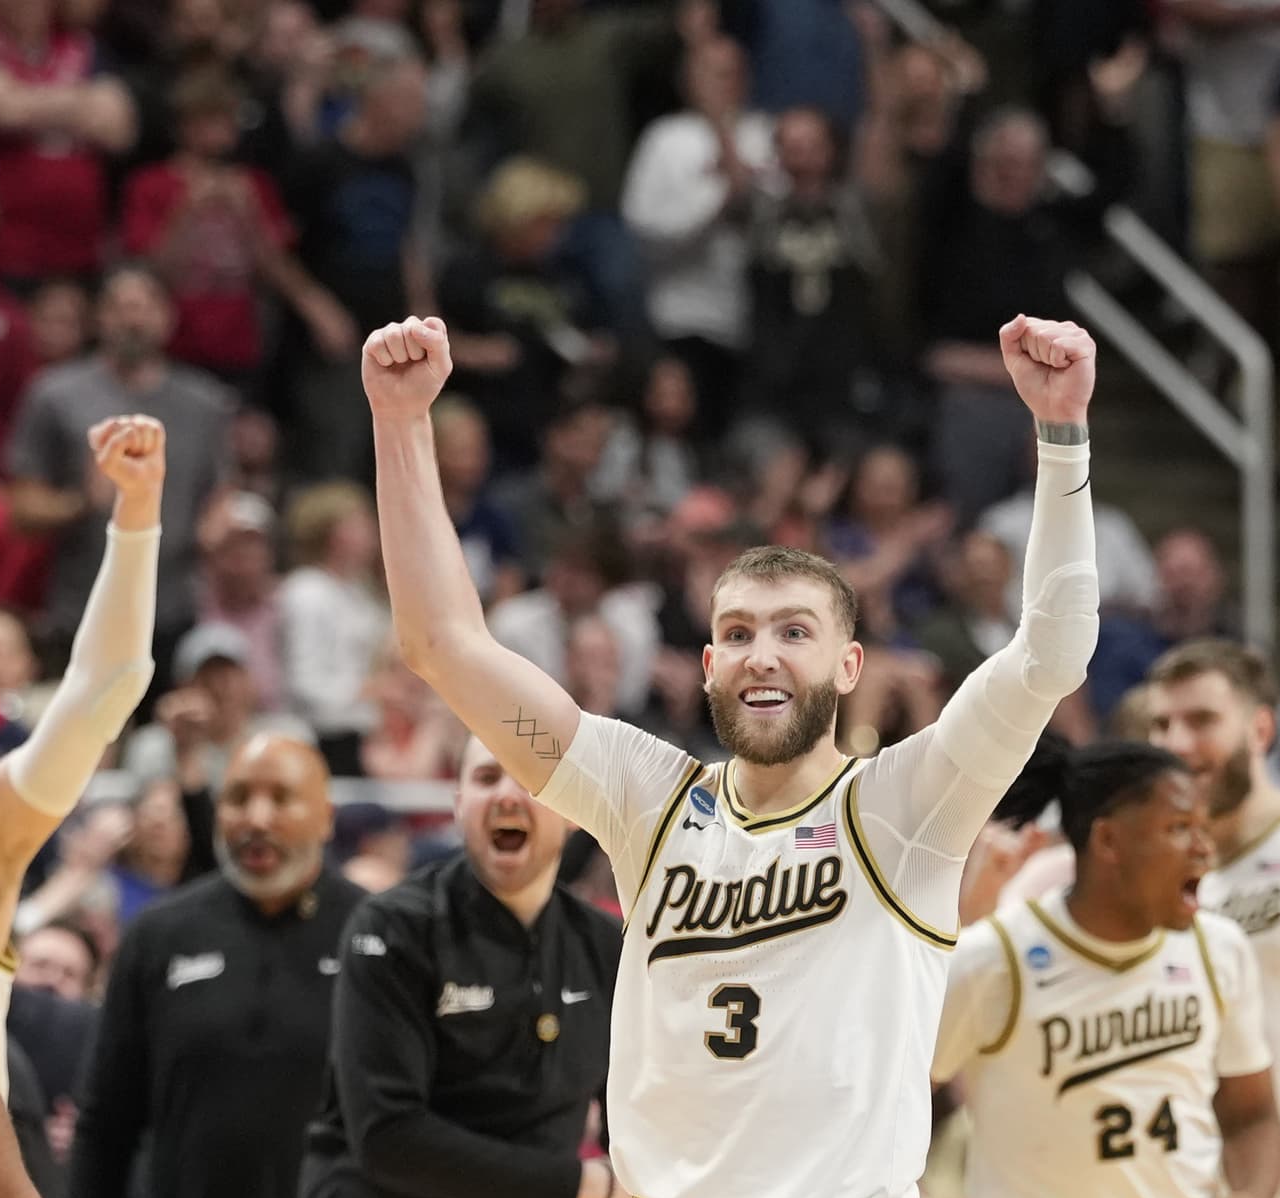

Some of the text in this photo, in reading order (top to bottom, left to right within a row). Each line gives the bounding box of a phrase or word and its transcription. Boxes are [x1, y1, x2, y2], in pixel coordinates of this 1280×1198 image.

[646, 856, 848, 958] Purdue
[704, 983, 762, 1061] 3
[1038, 992, 1202, 1085] Purdue
[1095, 1095, 1180, 1161] 24
